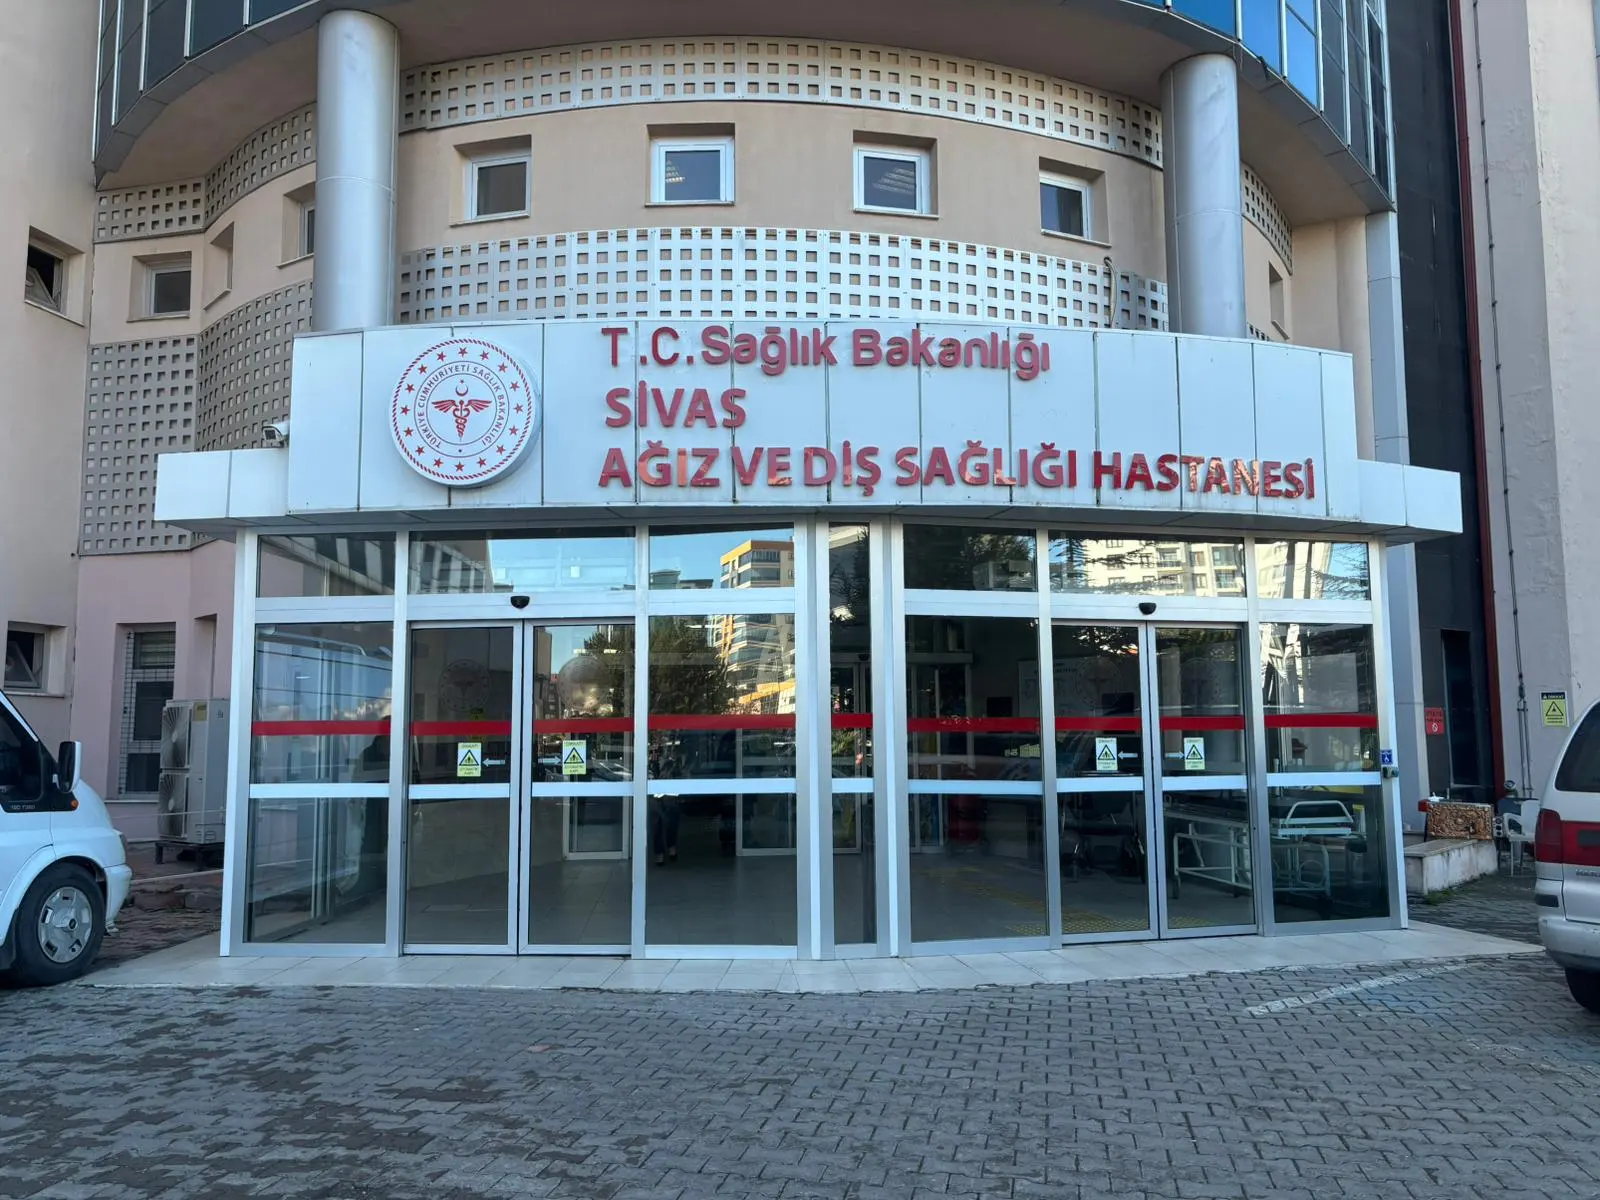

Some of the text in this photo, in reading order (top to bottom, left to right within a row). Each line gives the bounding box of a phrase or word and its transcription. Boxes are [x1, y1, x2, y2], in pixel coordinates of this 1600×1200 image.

[472, 366, 501, 392] SAĞLIK
[854, 329, 1050, 381] Bakanlığı
[418, 364, 470, 408] CUMHURİYETİ
[606, 380, 746, 428] SİVAS
[482, 394, 506, 446] BAKANLIĞI
[600, 440, 1315, 499] AĞIZ VE DİŞ SAĞLIĞI HASTANESİ
